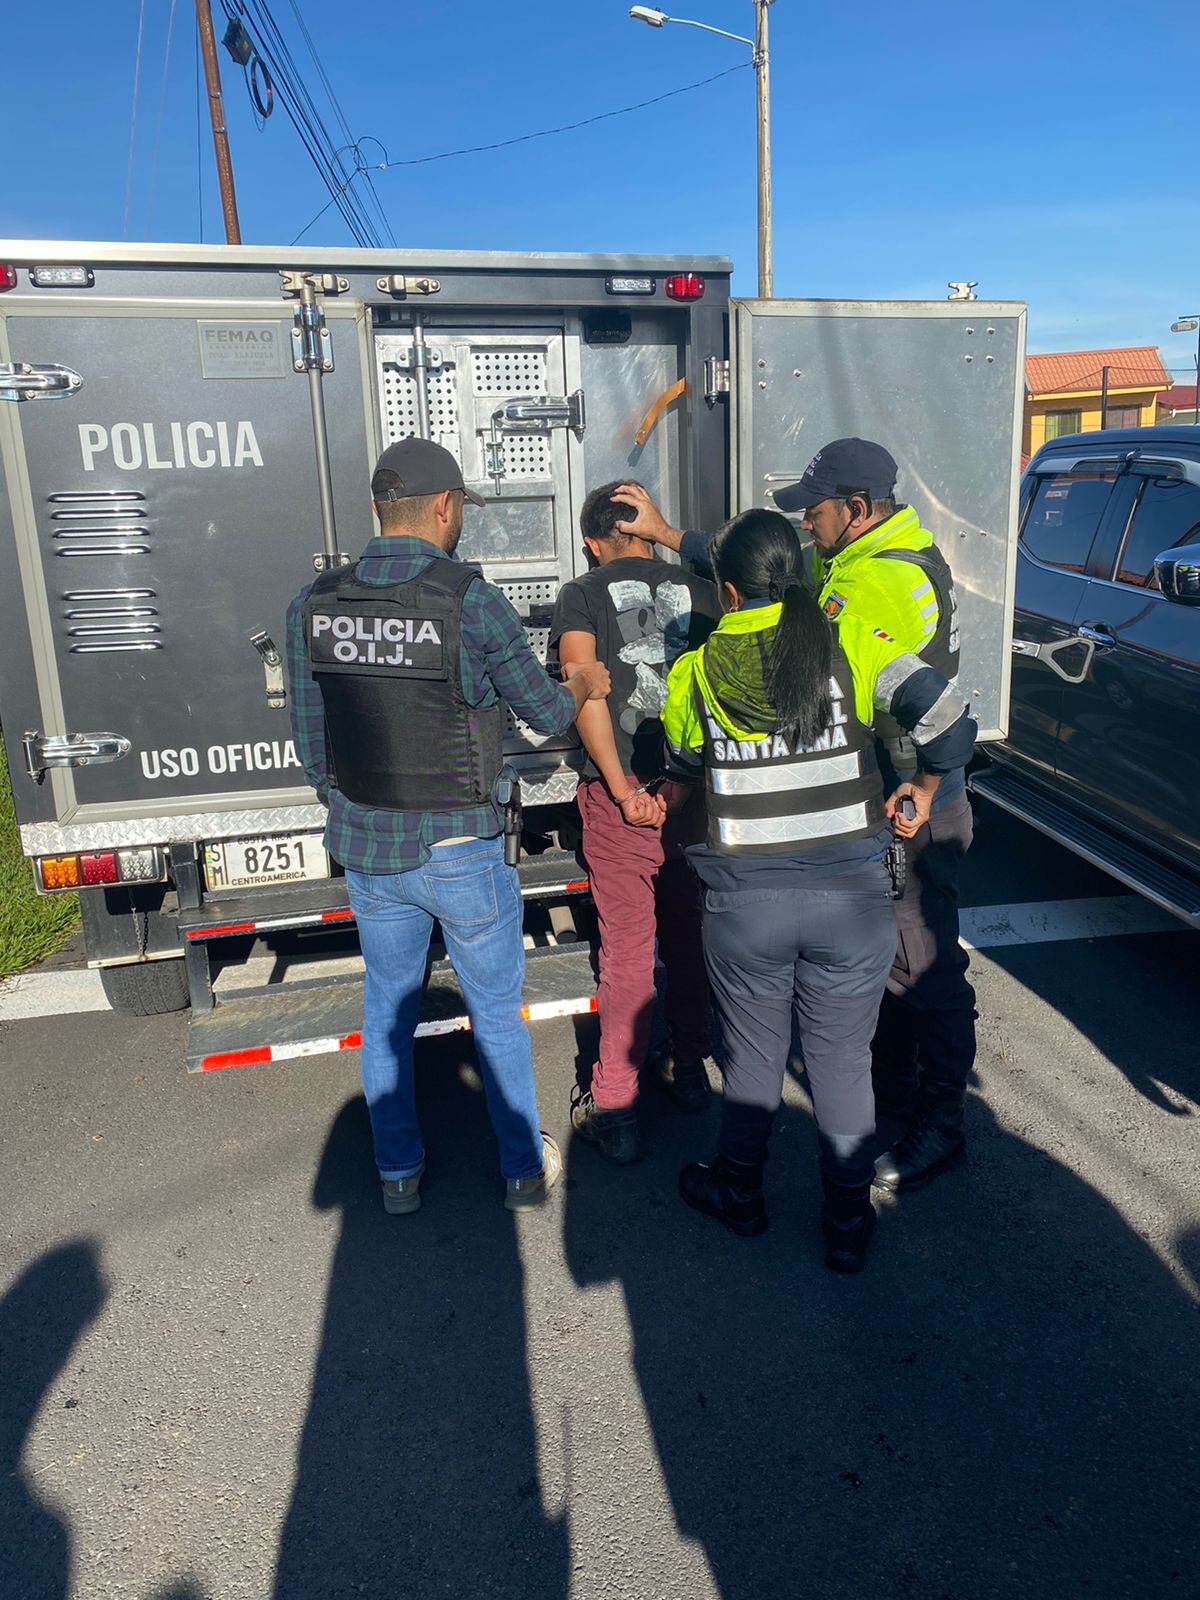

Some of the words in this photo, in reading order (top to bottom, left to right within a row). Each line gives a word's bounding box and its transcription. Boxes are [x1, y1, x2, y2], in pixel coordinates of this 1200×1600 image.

[205, 330, 273, 342] FEMAQ
[78, 421, 264, 471] POLICIA
[312, 615, 442, 644] POLICIA
[333, 640, 412, 665] O.I.J.
[140, 747, 199, 779] USO
[207, 740, 302, 774] OFICIA
[713, 735, 790, 761] SANTA
[237, 835, 268, 845] COSTA
[271, 832, 292, 842] RICA
[244, 841, 305, 874] 8251
[231, 871, 307, 886] CENTROAMERICA
